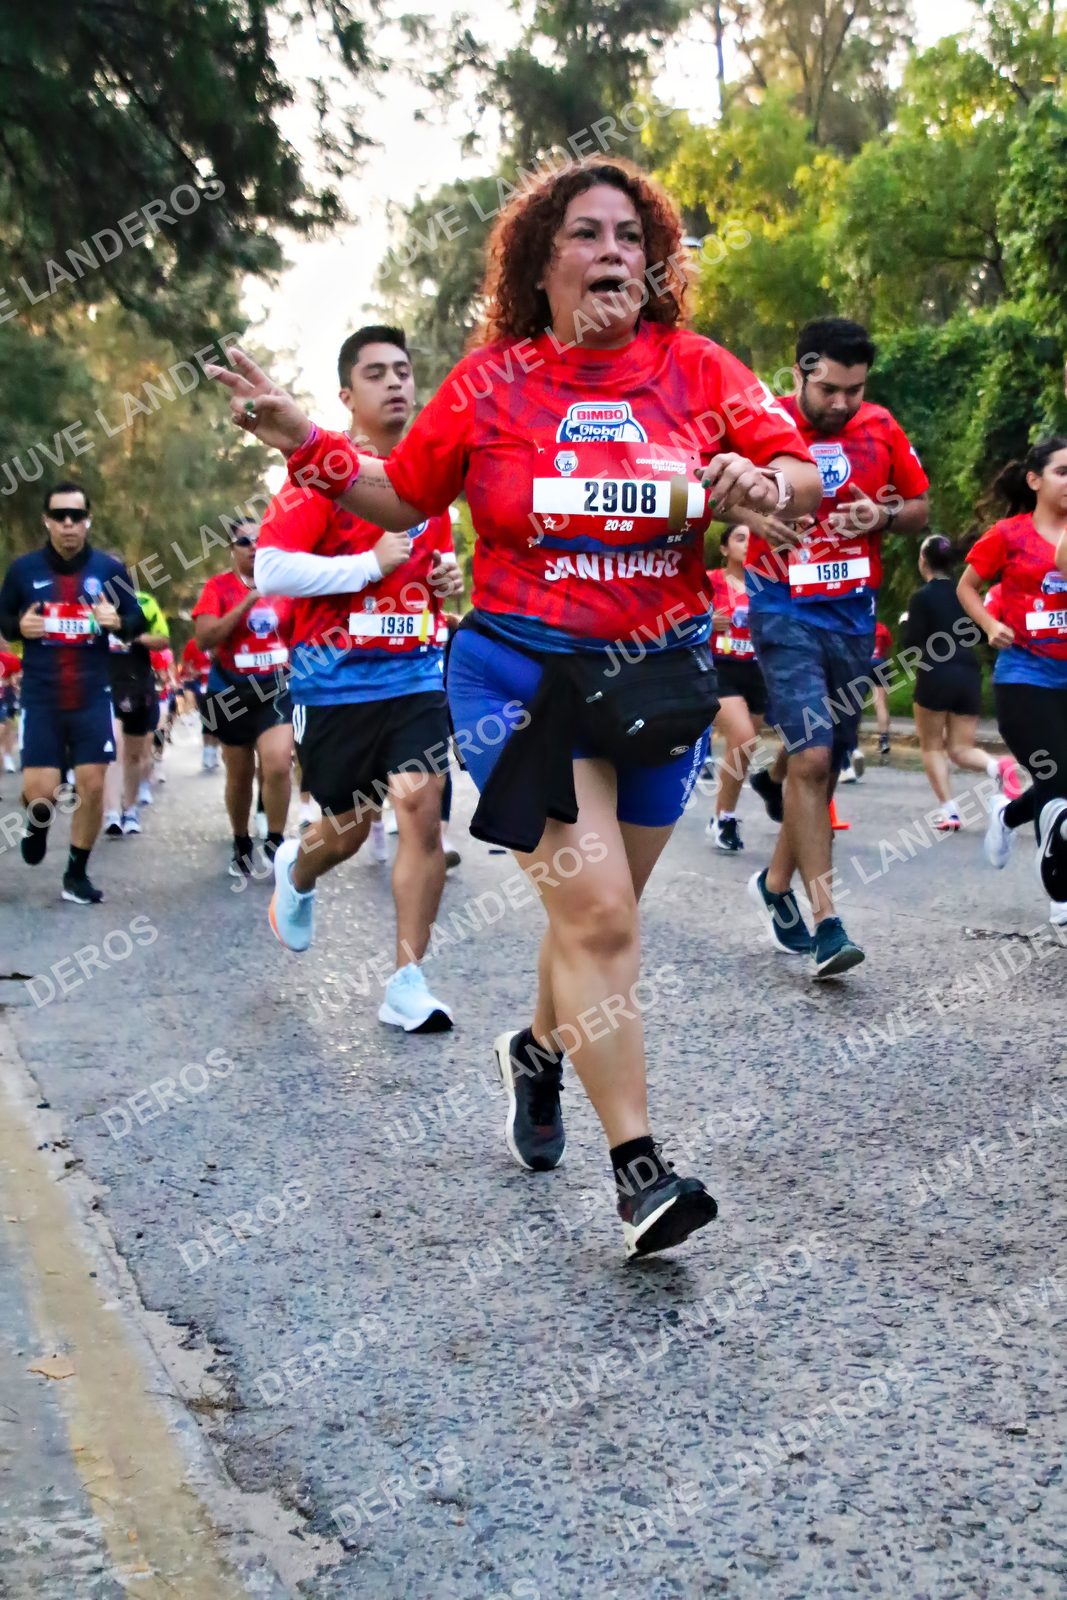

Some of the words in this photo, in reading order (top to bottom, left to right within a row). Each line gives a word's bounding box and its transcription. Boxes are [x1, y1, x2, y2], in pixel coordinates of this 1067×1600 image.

[577, 409, 623, 420] BIMBO
[579, 424, 624, 437] Global
[583, 481, 657, 514] 2908
[666, 534, 683, 543] 5K
[816, 562, 849, 581] 1588
[380, 616, 414, 635] 1936
